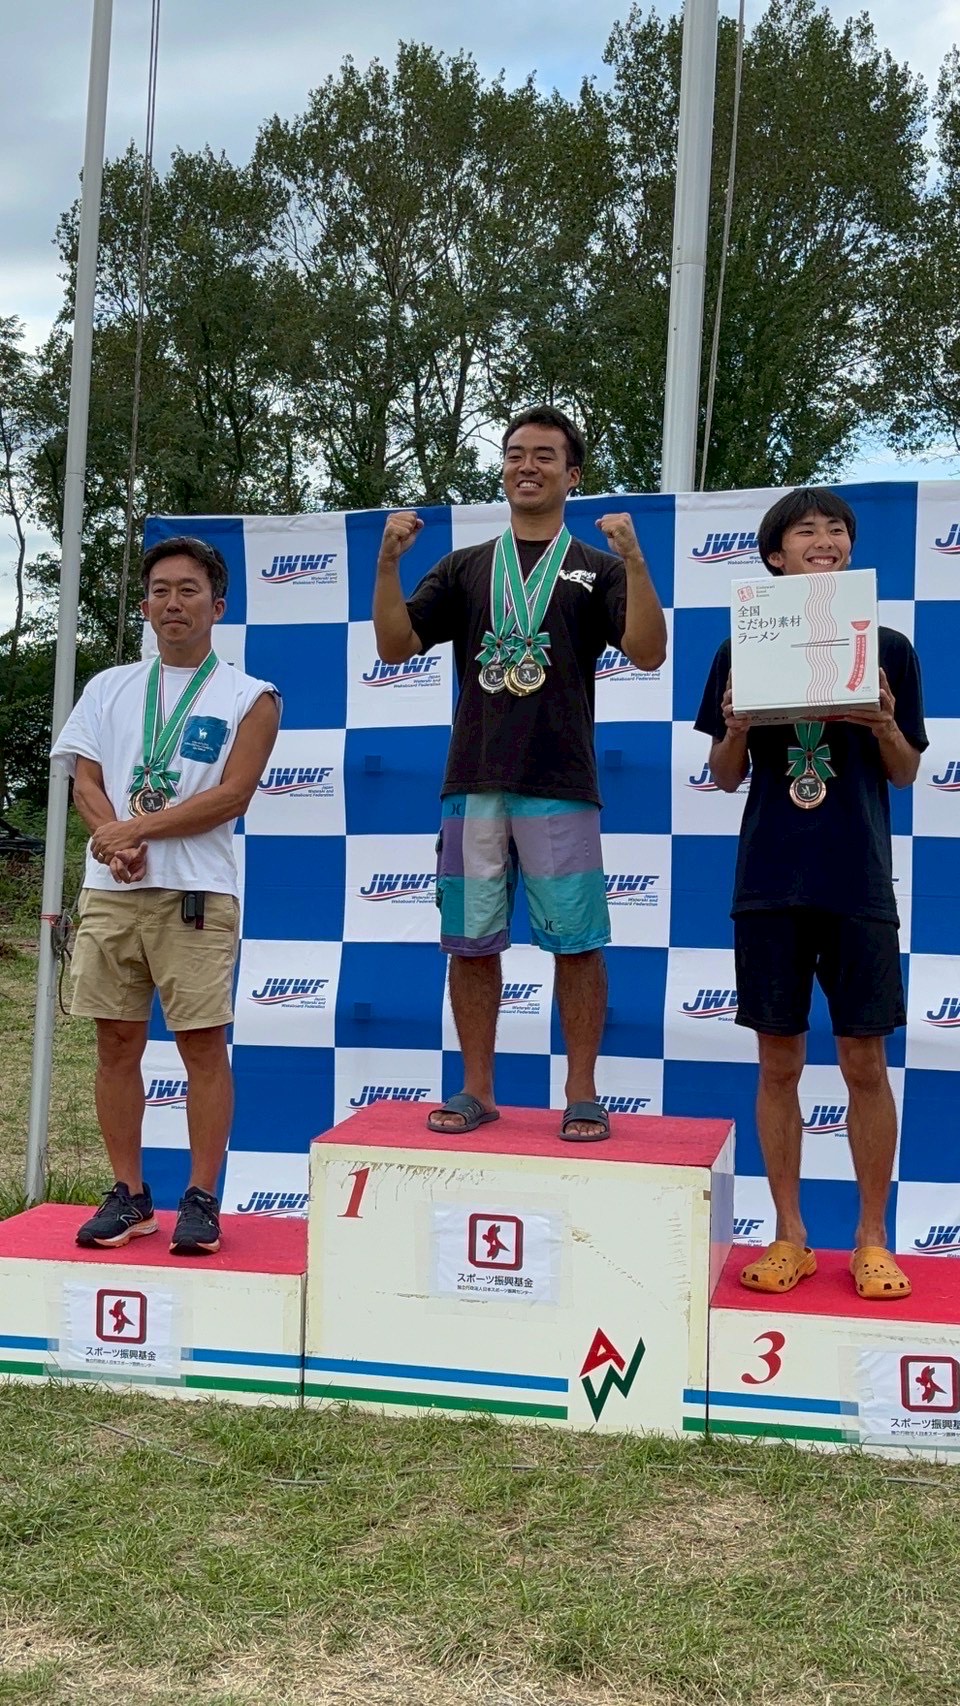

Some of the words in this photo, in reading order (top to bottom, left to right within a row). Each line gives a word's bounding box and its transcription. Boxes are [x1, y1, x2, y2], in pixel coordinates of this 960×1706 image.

[692, 532, 759, 557] JWW
[262, 554, 338, 578] JWWF
[738, 605, 760, 618] 全国
[738, 615, 802, 631] こだわり素材
[738, 631, 781, 645] ラーメン
[362, 656, 442, 681] JWWF
[258, 767, 335, 788] JWWF
[252, 978, 330, 999] JWWF
[501, 983, 543, 999] WF
[682, 989, 738, 1012] JW
[145, 1079, 188, 1100] JW
[350, 1086, 431, 1107] JWWF
[801, 1105, 847, 1127] JW
[337, 1167, 370, 1219] 1
[914, 1225, 960, 1248] JW
[457, 1272, 534, 1288] スポーツ振興基金
[85, 1346, 157, 1361] スポーツ振興基金
[741, 1331, 786, 1384] 3
[890, 1417, 960, 1430] スポーツ振興基
